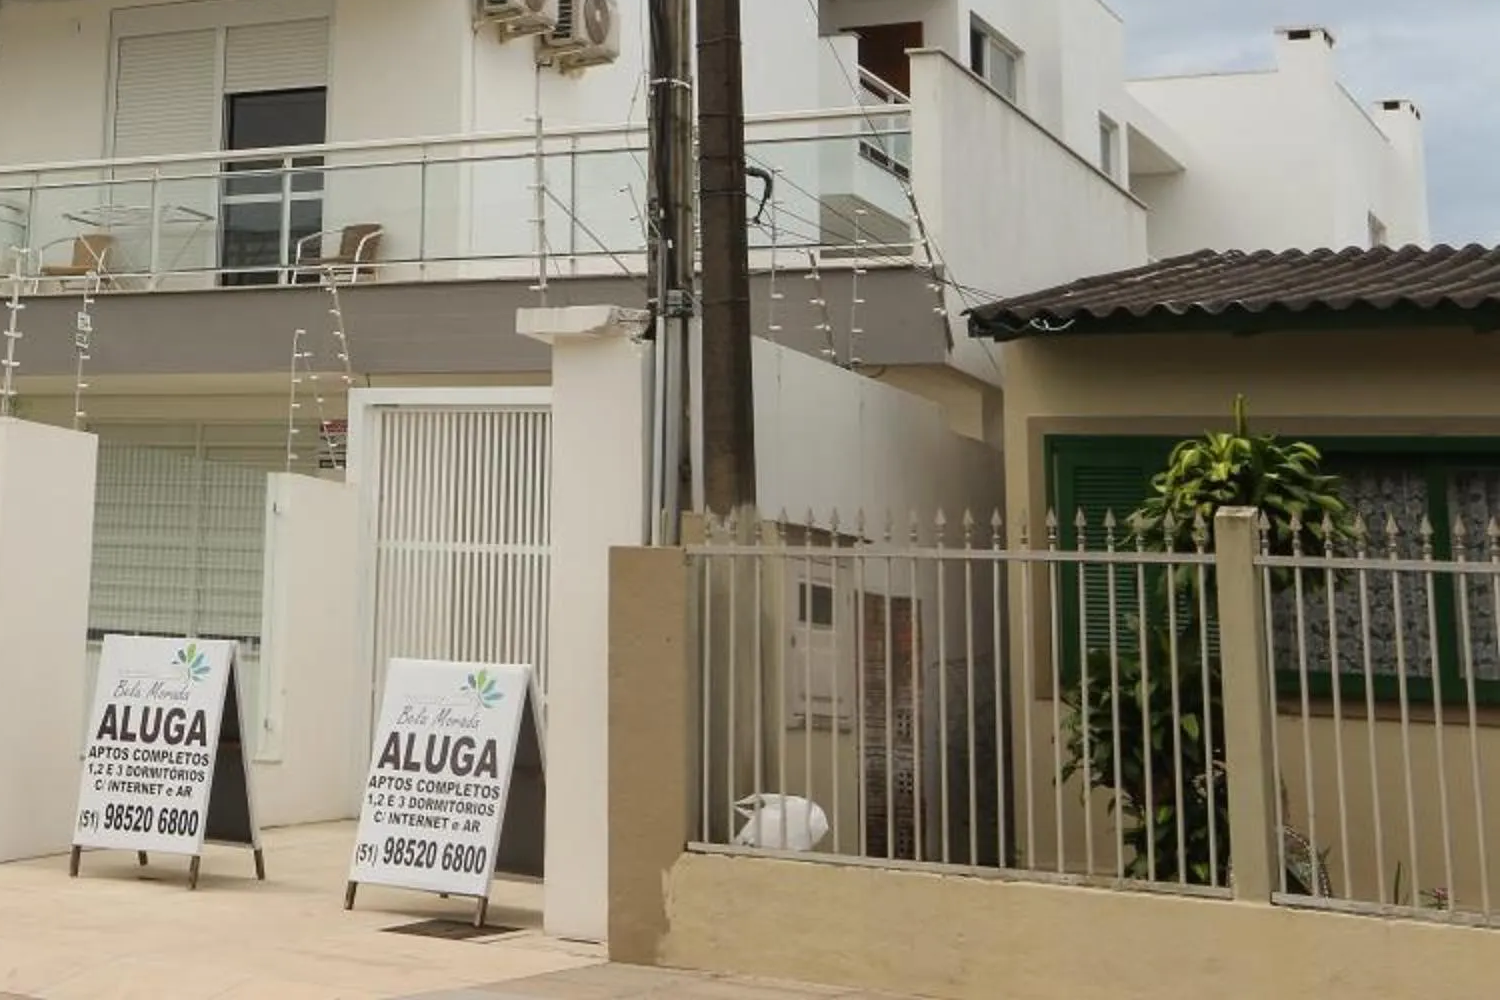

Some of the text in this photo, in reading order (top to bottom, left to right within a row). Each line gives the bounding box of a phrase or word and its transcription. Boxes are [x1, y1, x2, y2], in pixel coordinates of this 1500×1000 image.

[96, 703, 207, 747] ALUGA
[88, 746, 209, 767] APTOS COMPLETOS
[377, 731, 498, 779] ALUGA
[106, 764, 115, 776] E
[116, 764, 124, 776] 3
[107, 780, 164, 795] INTERNET
[175, 785, 193, 798] AR
[368, 775, 500, 800] APTOS COMPLETOS
[387, 794, 396, 807] E
[398, 795, 406, 809] 3
[79, 803, 199, 836] (51) 98520 6800
[387, 812, 450, 829] INTERNET
[463, 819, 481, 833] AR
[355, 836, 487, 875] (51) 98520 6800
